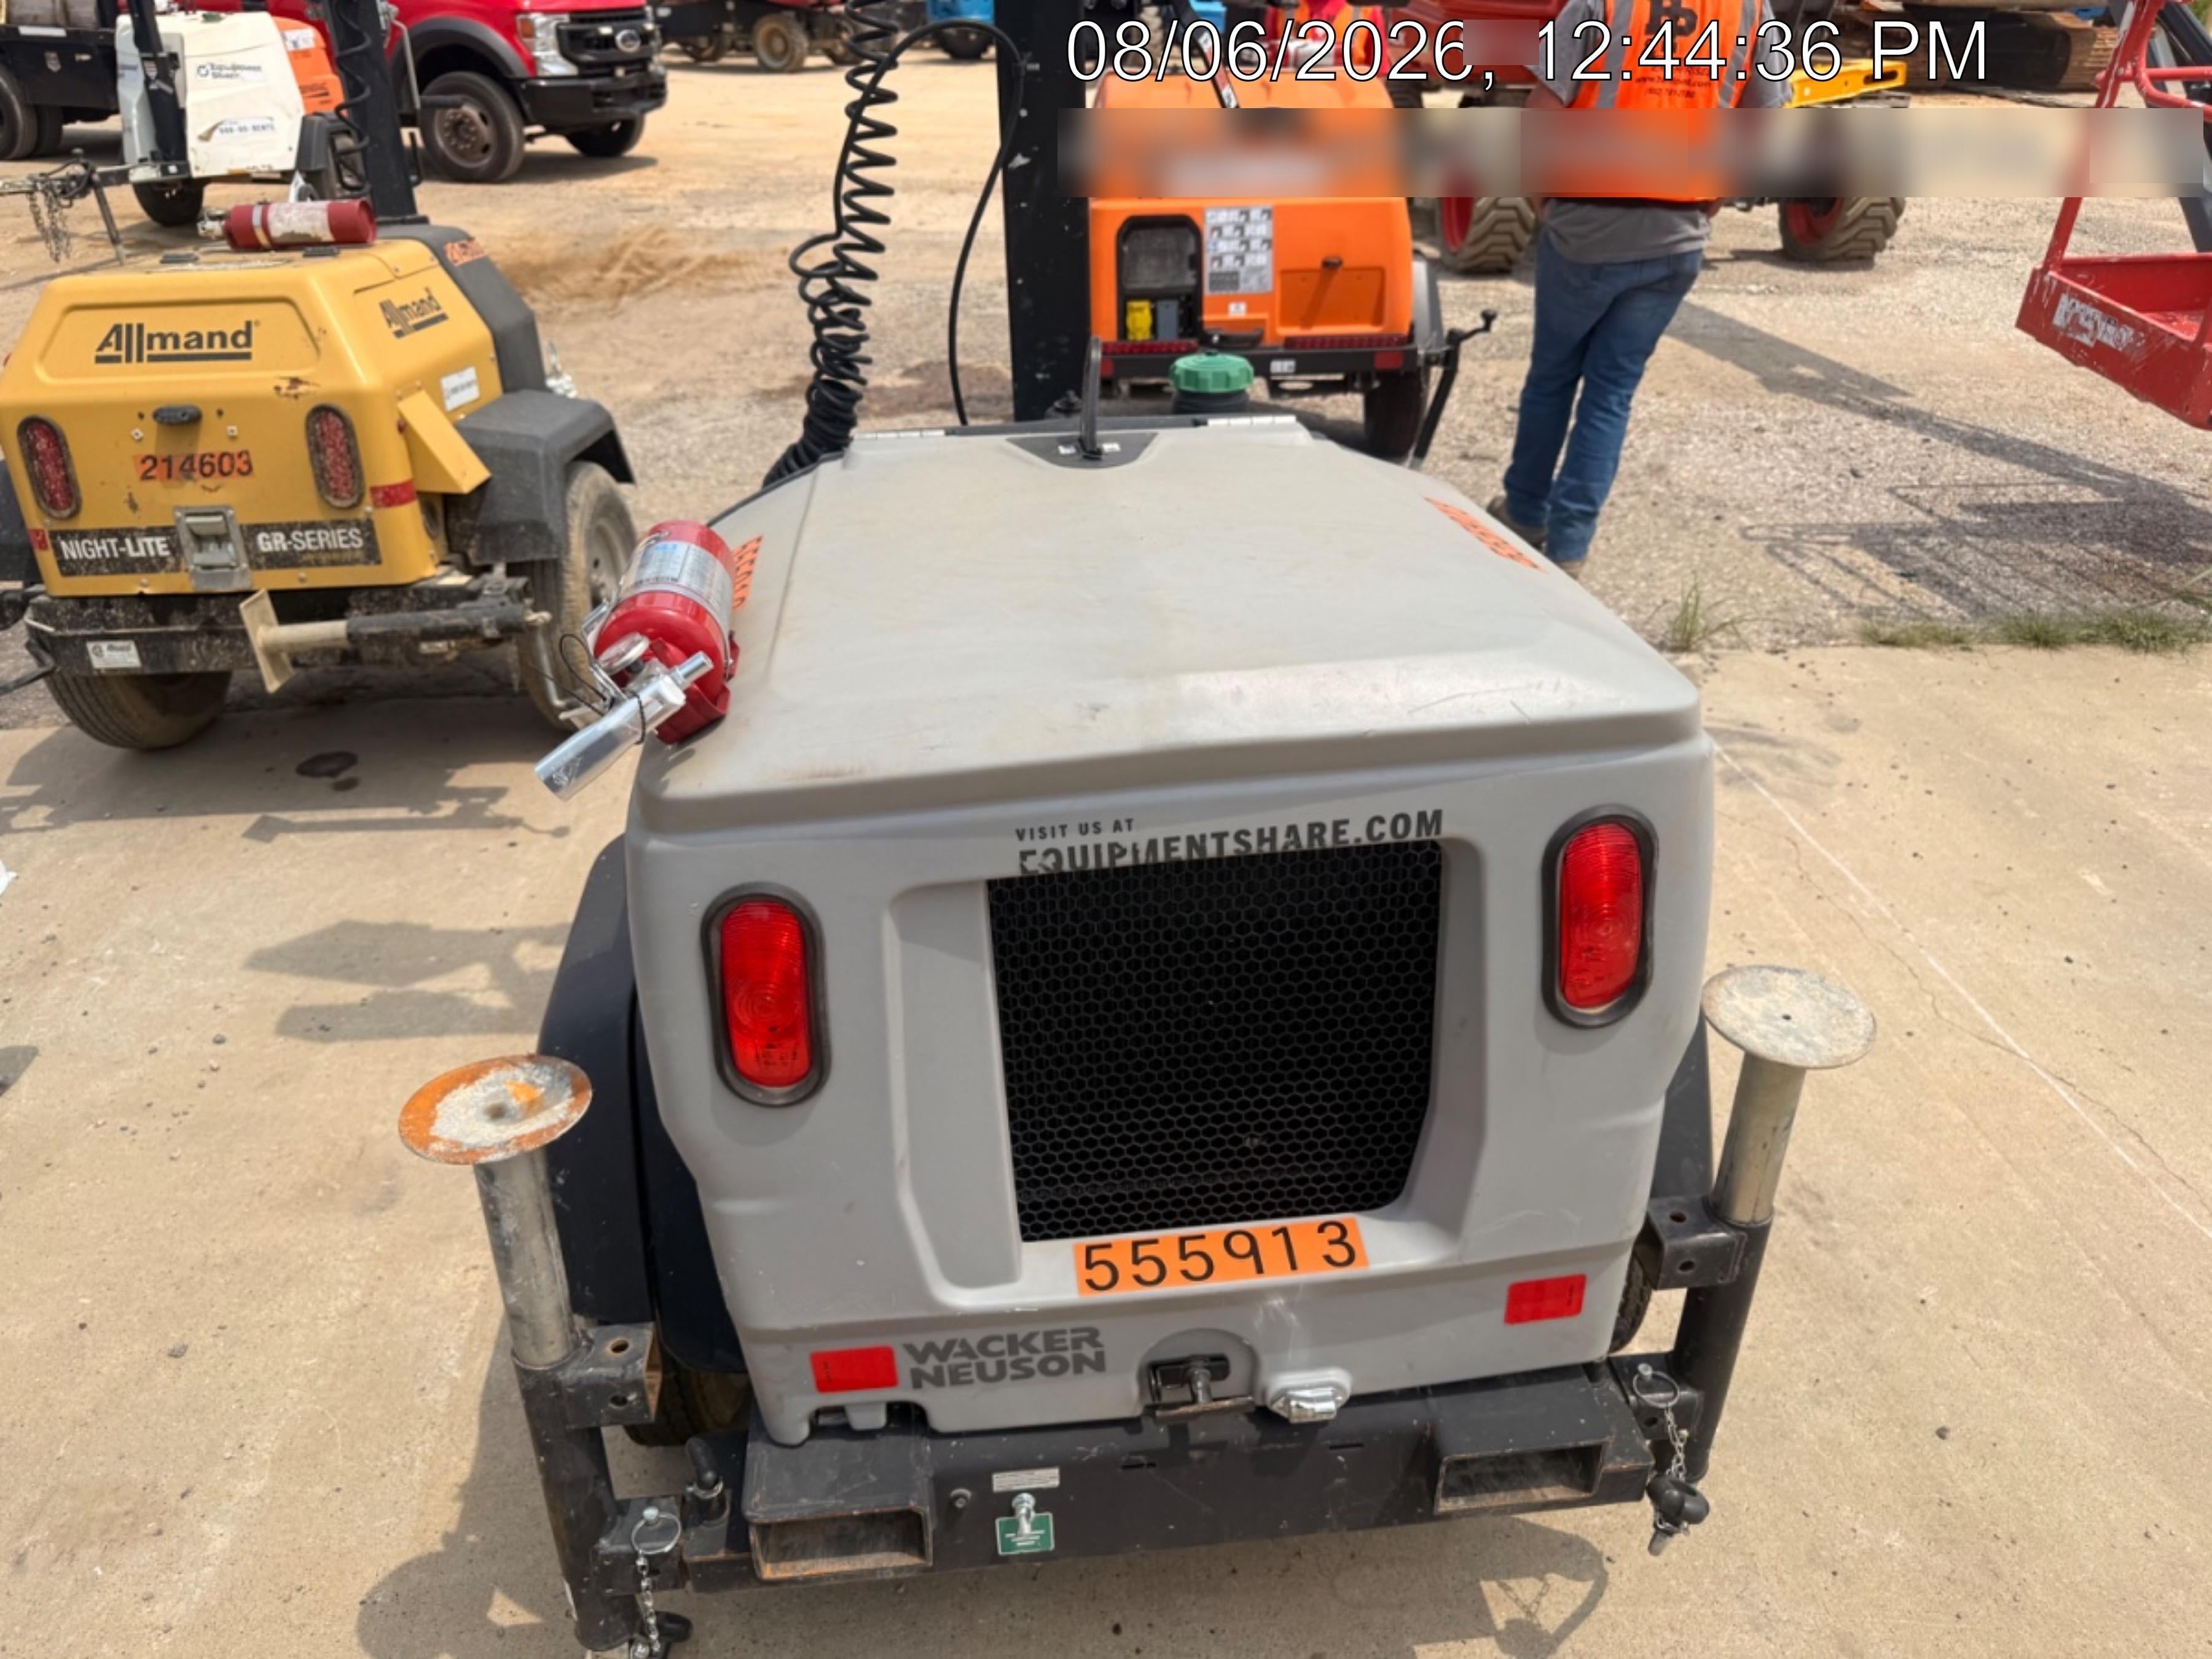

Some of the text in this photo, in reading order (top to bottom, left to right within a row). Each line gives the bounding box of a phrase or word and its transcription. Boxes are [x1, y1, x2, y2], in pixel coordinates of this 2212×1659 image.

[379, 286, 446, 337] Allmand
[95, 320, 252, 364] Allmand
[140, 450, 253, 481] 214603
[60, 528, 364, 560] NIGHT-LITE GR-SERIES
[1015, 817, 1135, 842] VISIT US AT
[1084, 1220, 1357, 1292] 555913
[902, 1327, 1105, 1365] WACKER
[909, 1351, 1107, 1390] NEUSON
